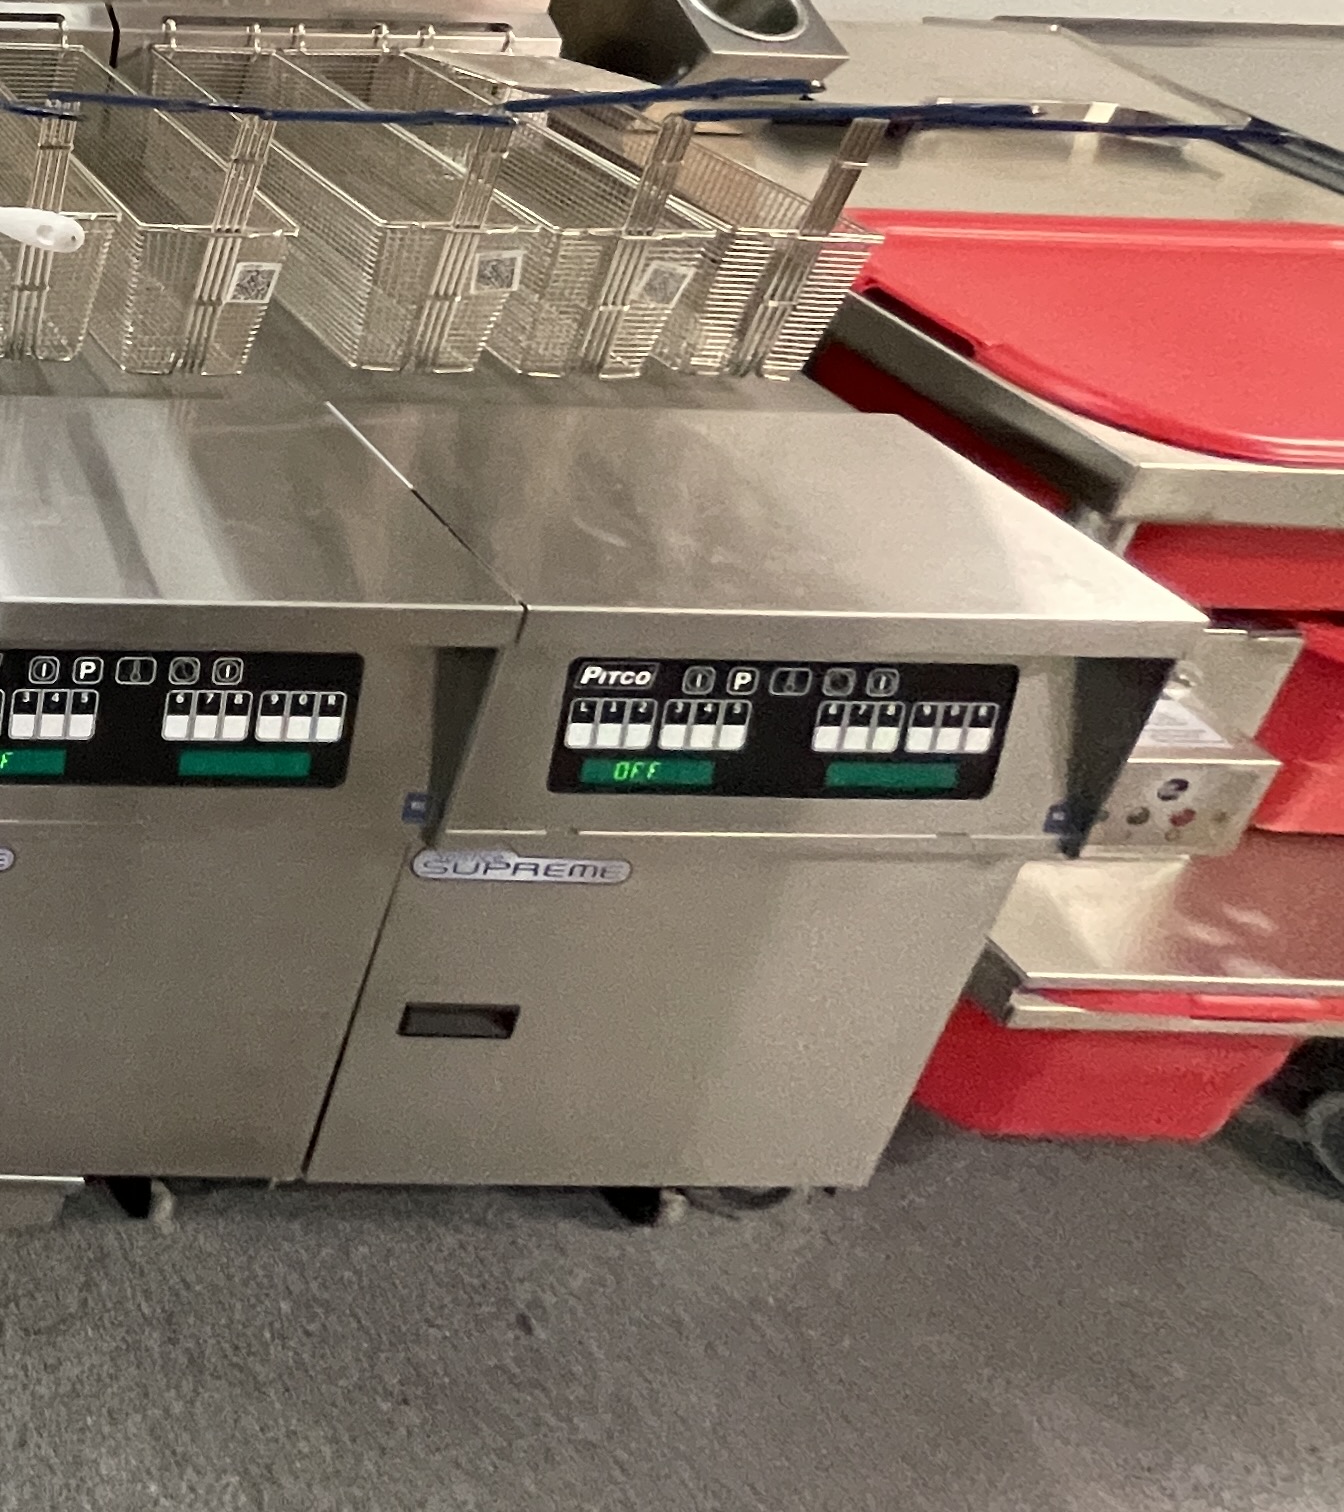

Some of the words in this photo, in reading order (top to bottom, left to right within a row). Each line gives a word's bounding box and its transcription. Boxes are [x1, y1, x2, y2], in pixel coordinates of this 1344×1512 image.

[80, 661, 96, 680] P
[733, 672, 752, 690] P
[614, 761, 662, 781] OFF
[421, 861, 624, 879] SUPREME
